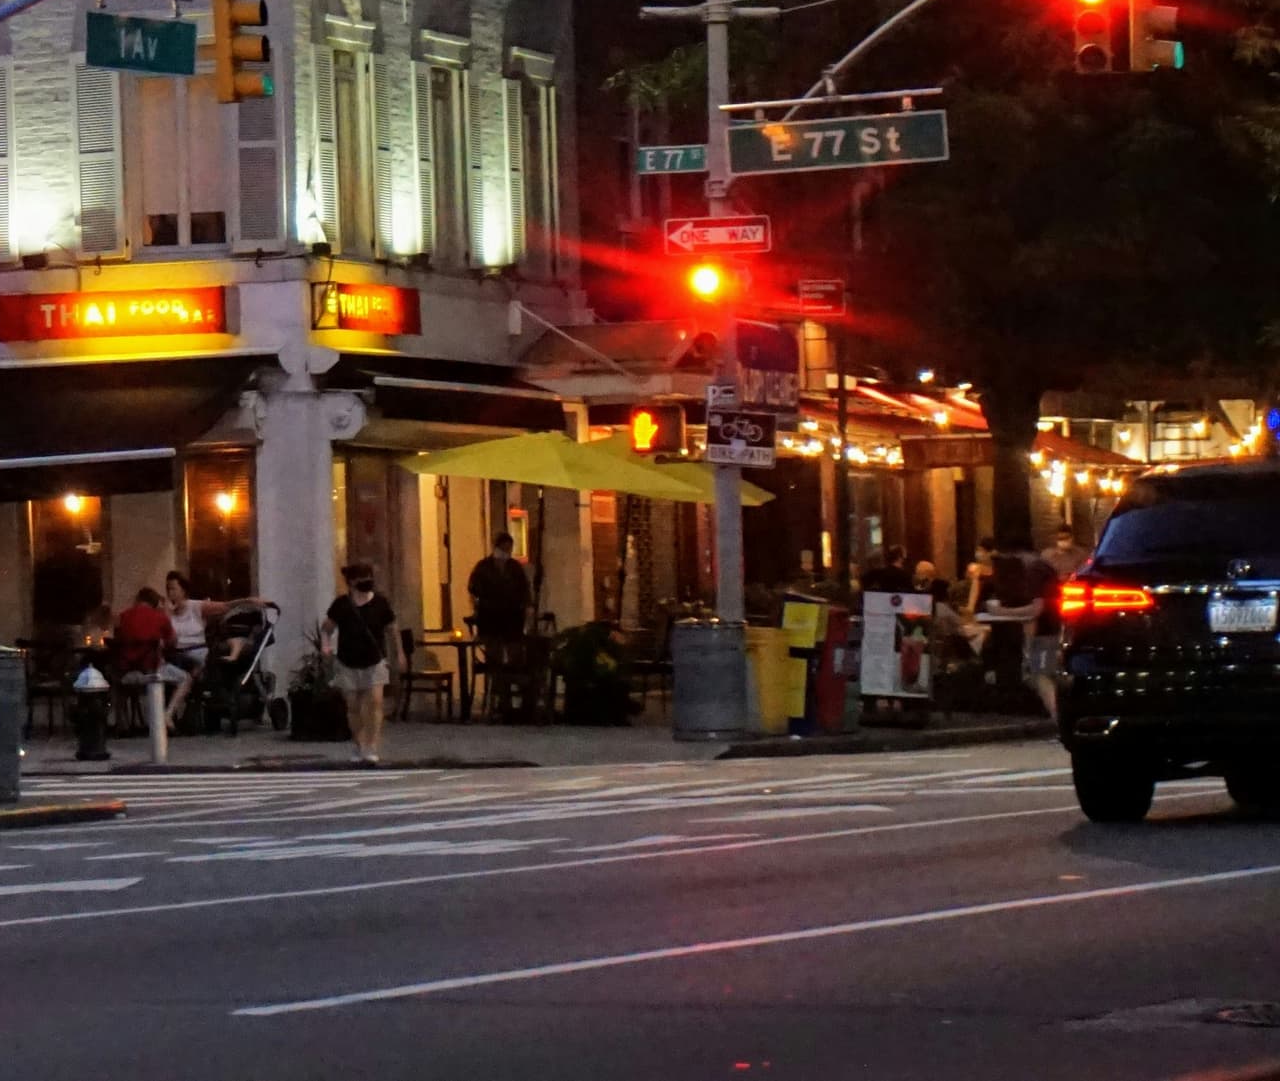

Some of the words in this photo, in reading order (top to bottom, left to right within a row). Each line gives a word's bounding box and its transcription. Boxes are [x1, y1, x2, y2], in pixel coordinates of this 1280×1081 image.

[804, 130, 845, 158] 77
[860, 127, 901, 155] St
[646, 151, 656, 170] E
[664, 150, 685, 169] 77
[681, 230, 710, 243] ONE
[727, 228, 759, 241] WAY
[40, 301, 116, 328] THAI
[129, 299, 184, 315] FOOD
